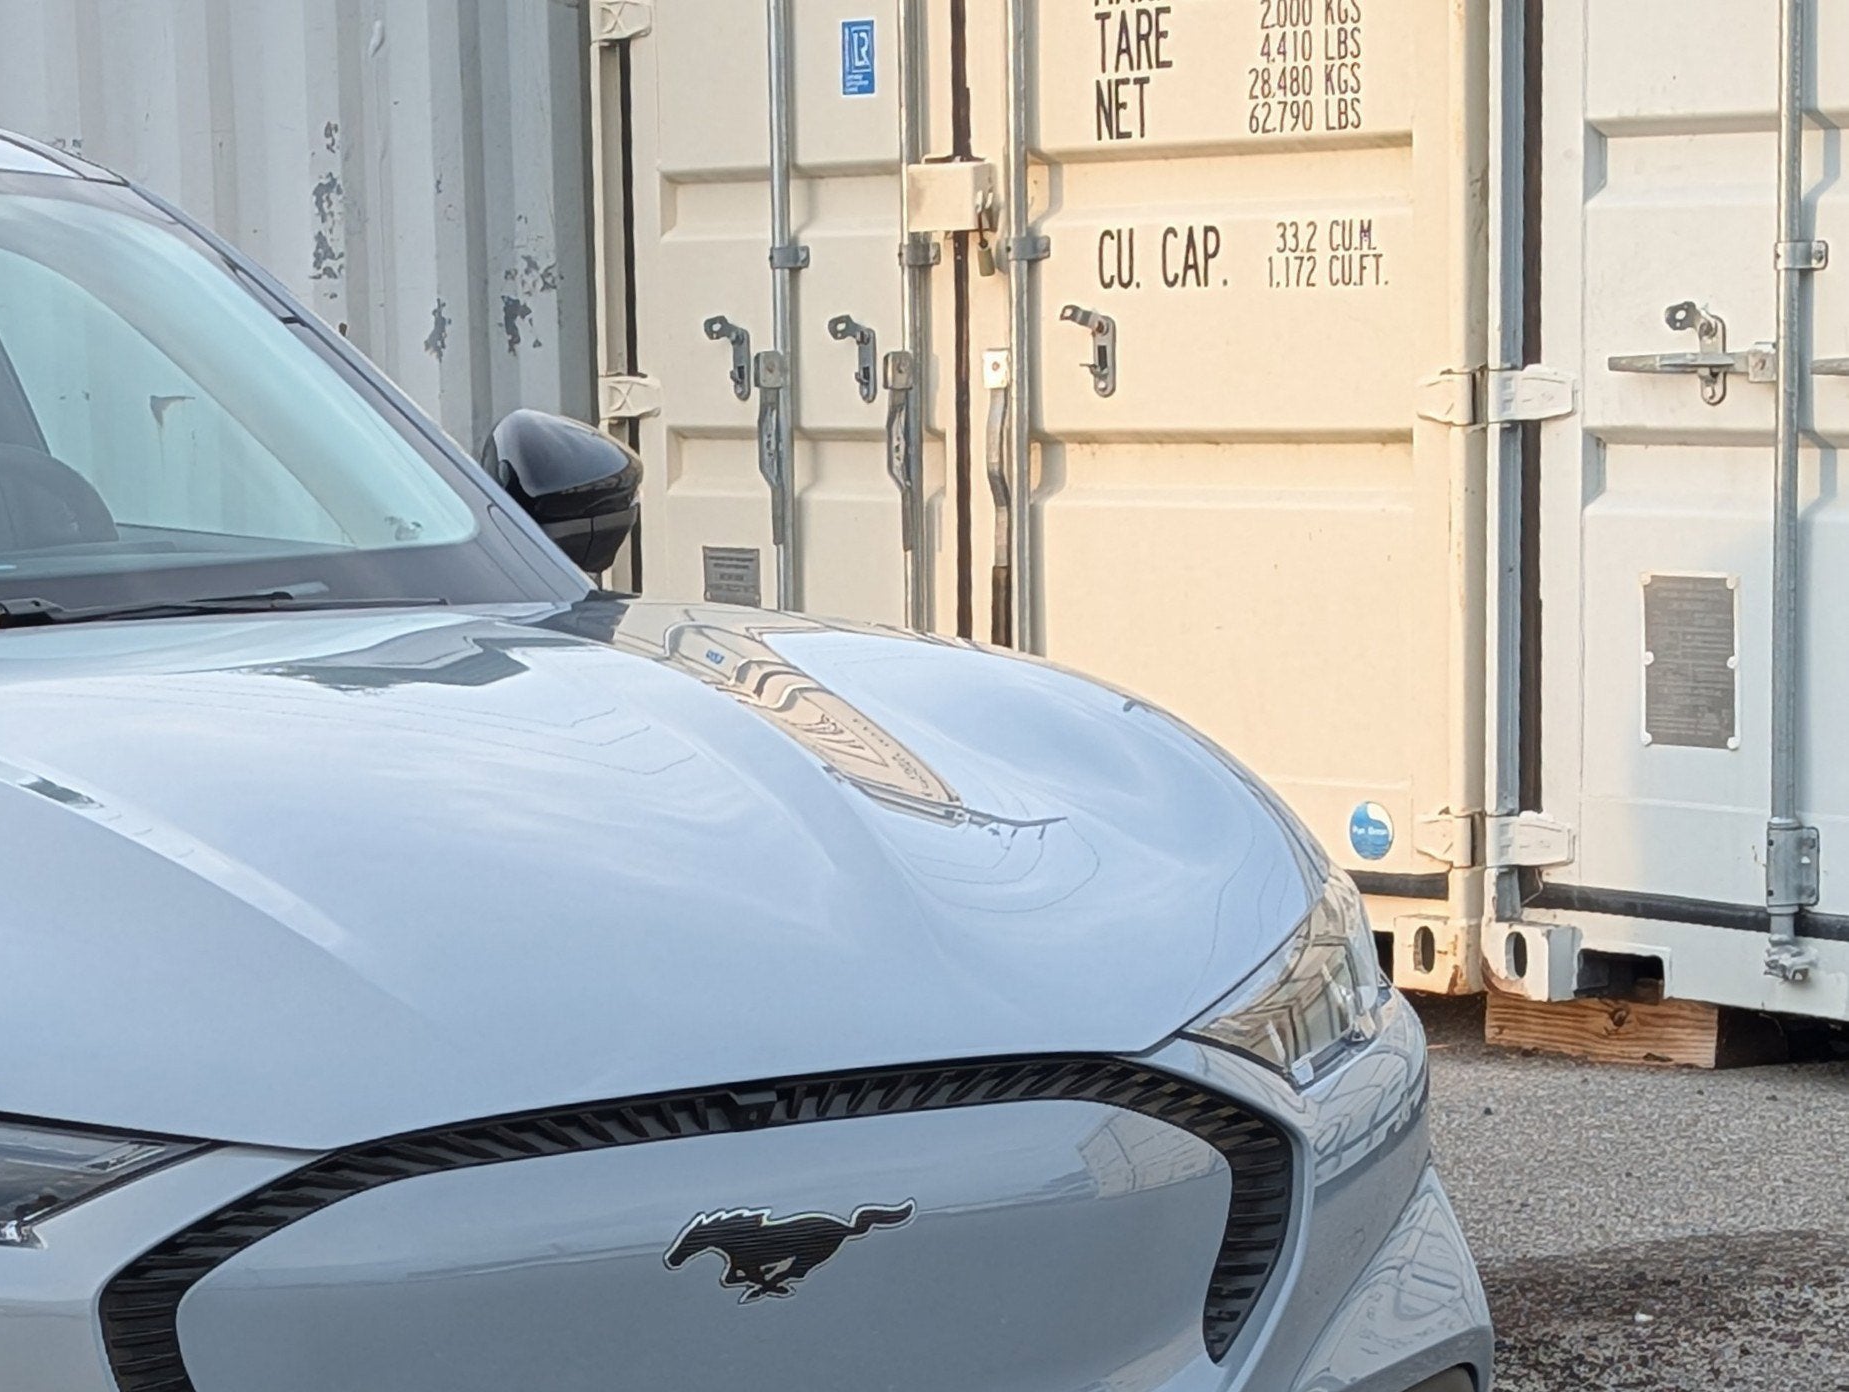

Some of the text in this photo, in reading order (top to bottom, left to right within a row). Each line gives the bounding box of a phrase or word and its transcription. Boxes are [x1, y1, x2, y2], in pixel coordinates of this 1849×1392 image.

[1324, 0, 1361, 25] KGS
[1094, 6, 1173, 73] TARE
[1324, 27, 1361, 60] LBS
[1324, 62, 1361, 95] KGS
[1096, 76, 1150, 141] NET
[1324, 97, 1361, 130] LBS
[1276, 221, 1317, 253] 33.2
[1098, 225, 1228, 289] CU. CAP.
